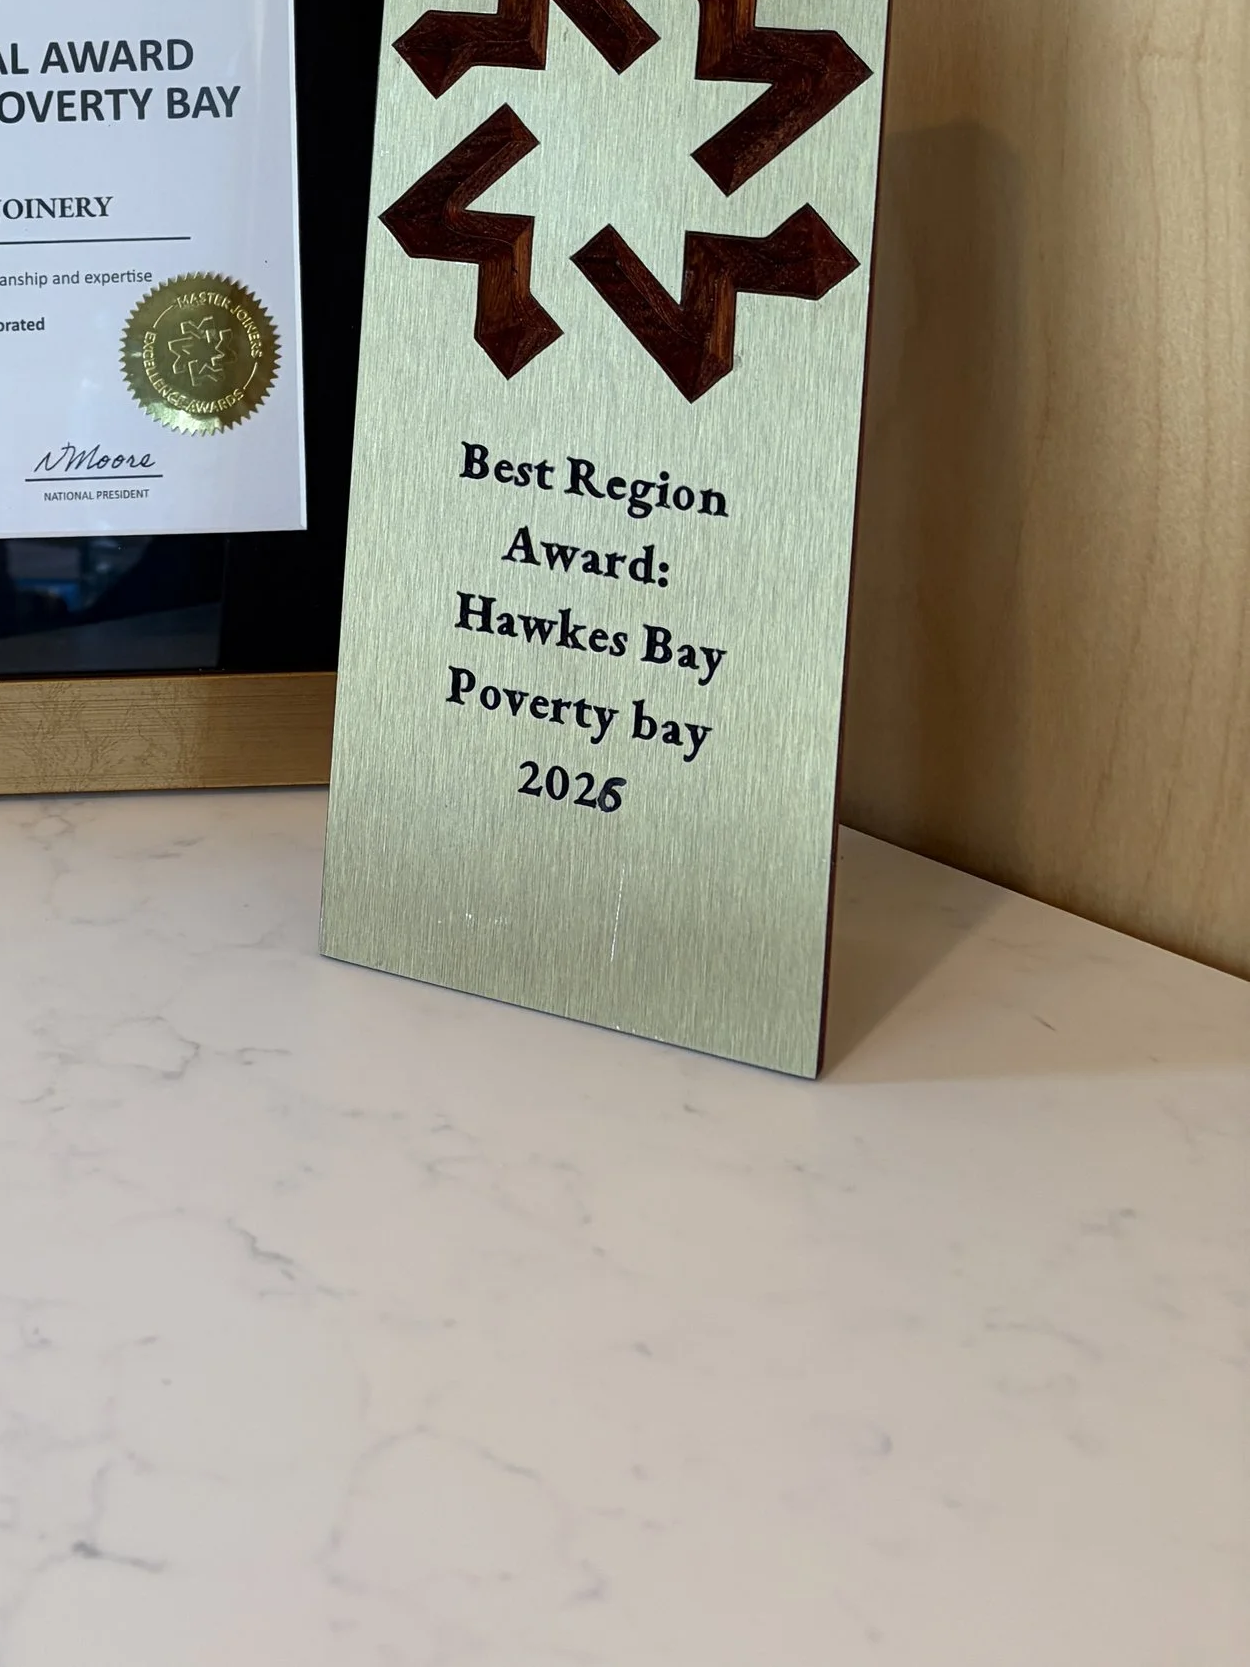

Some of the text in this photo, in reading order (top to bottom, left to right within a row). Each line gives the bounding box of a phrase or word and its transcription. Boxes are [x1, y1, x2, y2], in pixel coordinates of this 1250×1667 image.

[40, 38, 195, 74] AWARD
[167, 85, 242, 119] BAY
[52, 271, 81, 286] and
[85, 270, 152, 286] expertise
[230, 304, 263, 359] JOINERS
[142, 331, 245, 414] EXCELLENCE AWARDS
[43, 488, 150, 502] NATIONAL PRESIDENT
[459, 441, 729, 519] Best Region
[501, 525, 670, 588] Award:
[454, 591, 728, 687] Hawkes Bay
[446, 665, 712, 763] Poverty bay
[517, 760, 627, 813] 2026
